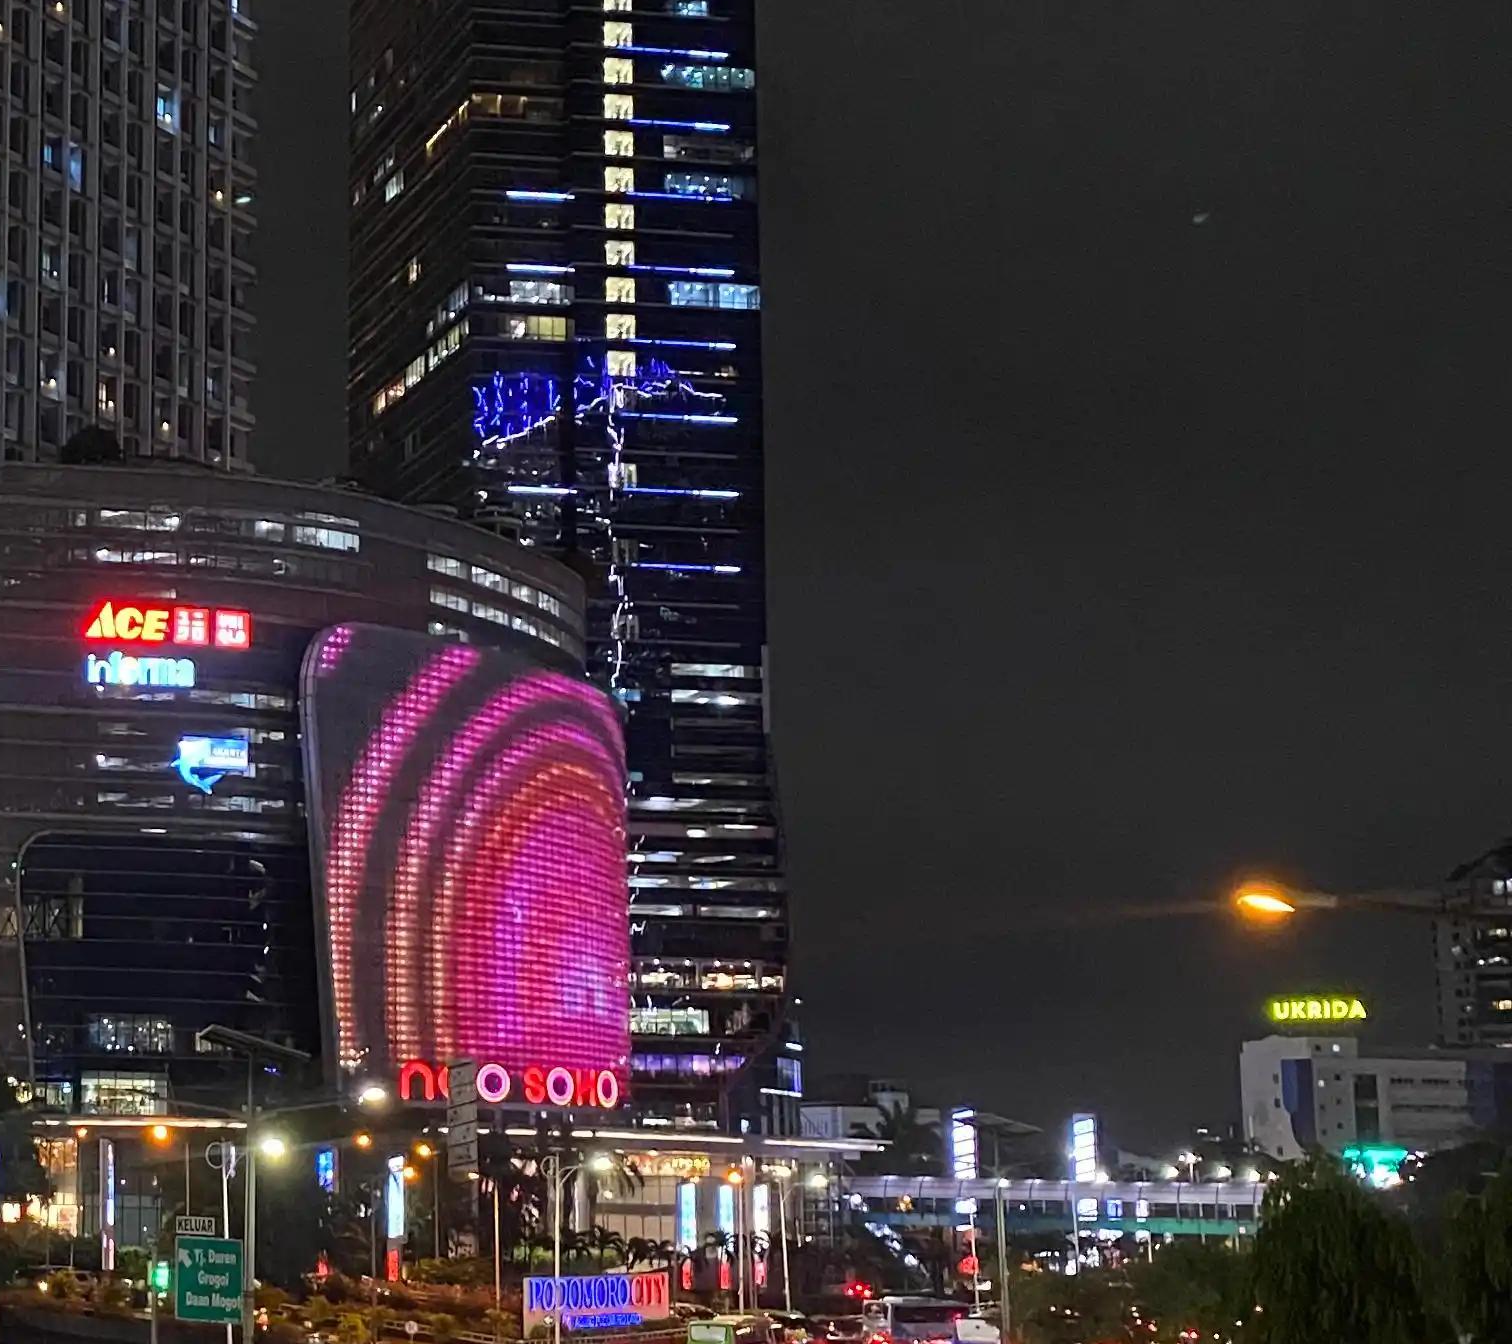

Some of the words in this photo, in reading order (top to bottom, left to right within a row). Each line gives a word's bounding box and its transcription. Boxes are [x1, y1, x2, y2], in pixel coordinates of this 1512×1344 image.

[86, 601, 170, 641] ACE
[87, 650, 196, 688] informa
[1272, 999, 1367, 1020] UKRIDA
[523, 1066, 619, 1108] SOHO
[177, 1218, 215, 1233] KELUAR
[208, 1249, 237, 1265] Duren
[631, 1273, 664, 1306] CITY
